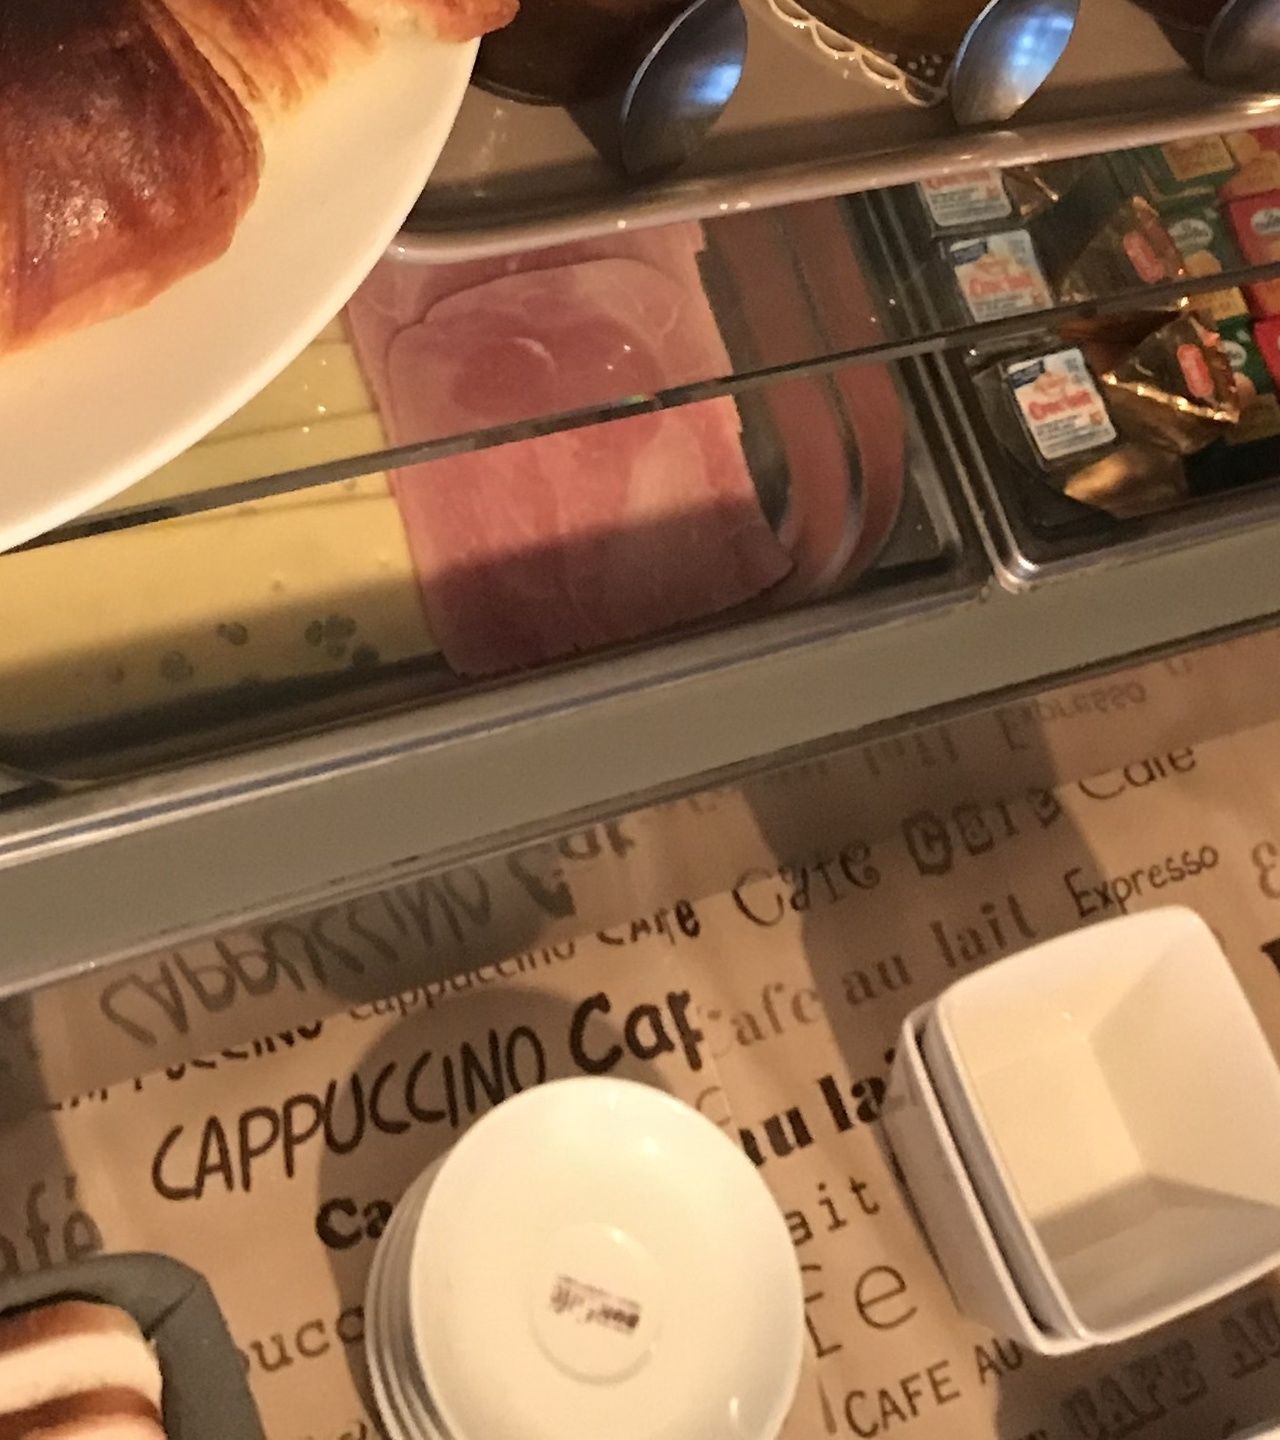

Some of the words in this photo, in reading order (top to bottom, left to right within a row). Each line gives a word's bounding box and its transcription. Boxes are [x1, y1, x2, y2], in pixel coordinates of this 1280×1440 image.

[1064, 845, 1219, 919] Expresso
[841, 955, 912, 1006] au
[152, 1025, 546, 1201] CAPPUCCINO
[844, 1359, 961, 1438] CAFE
